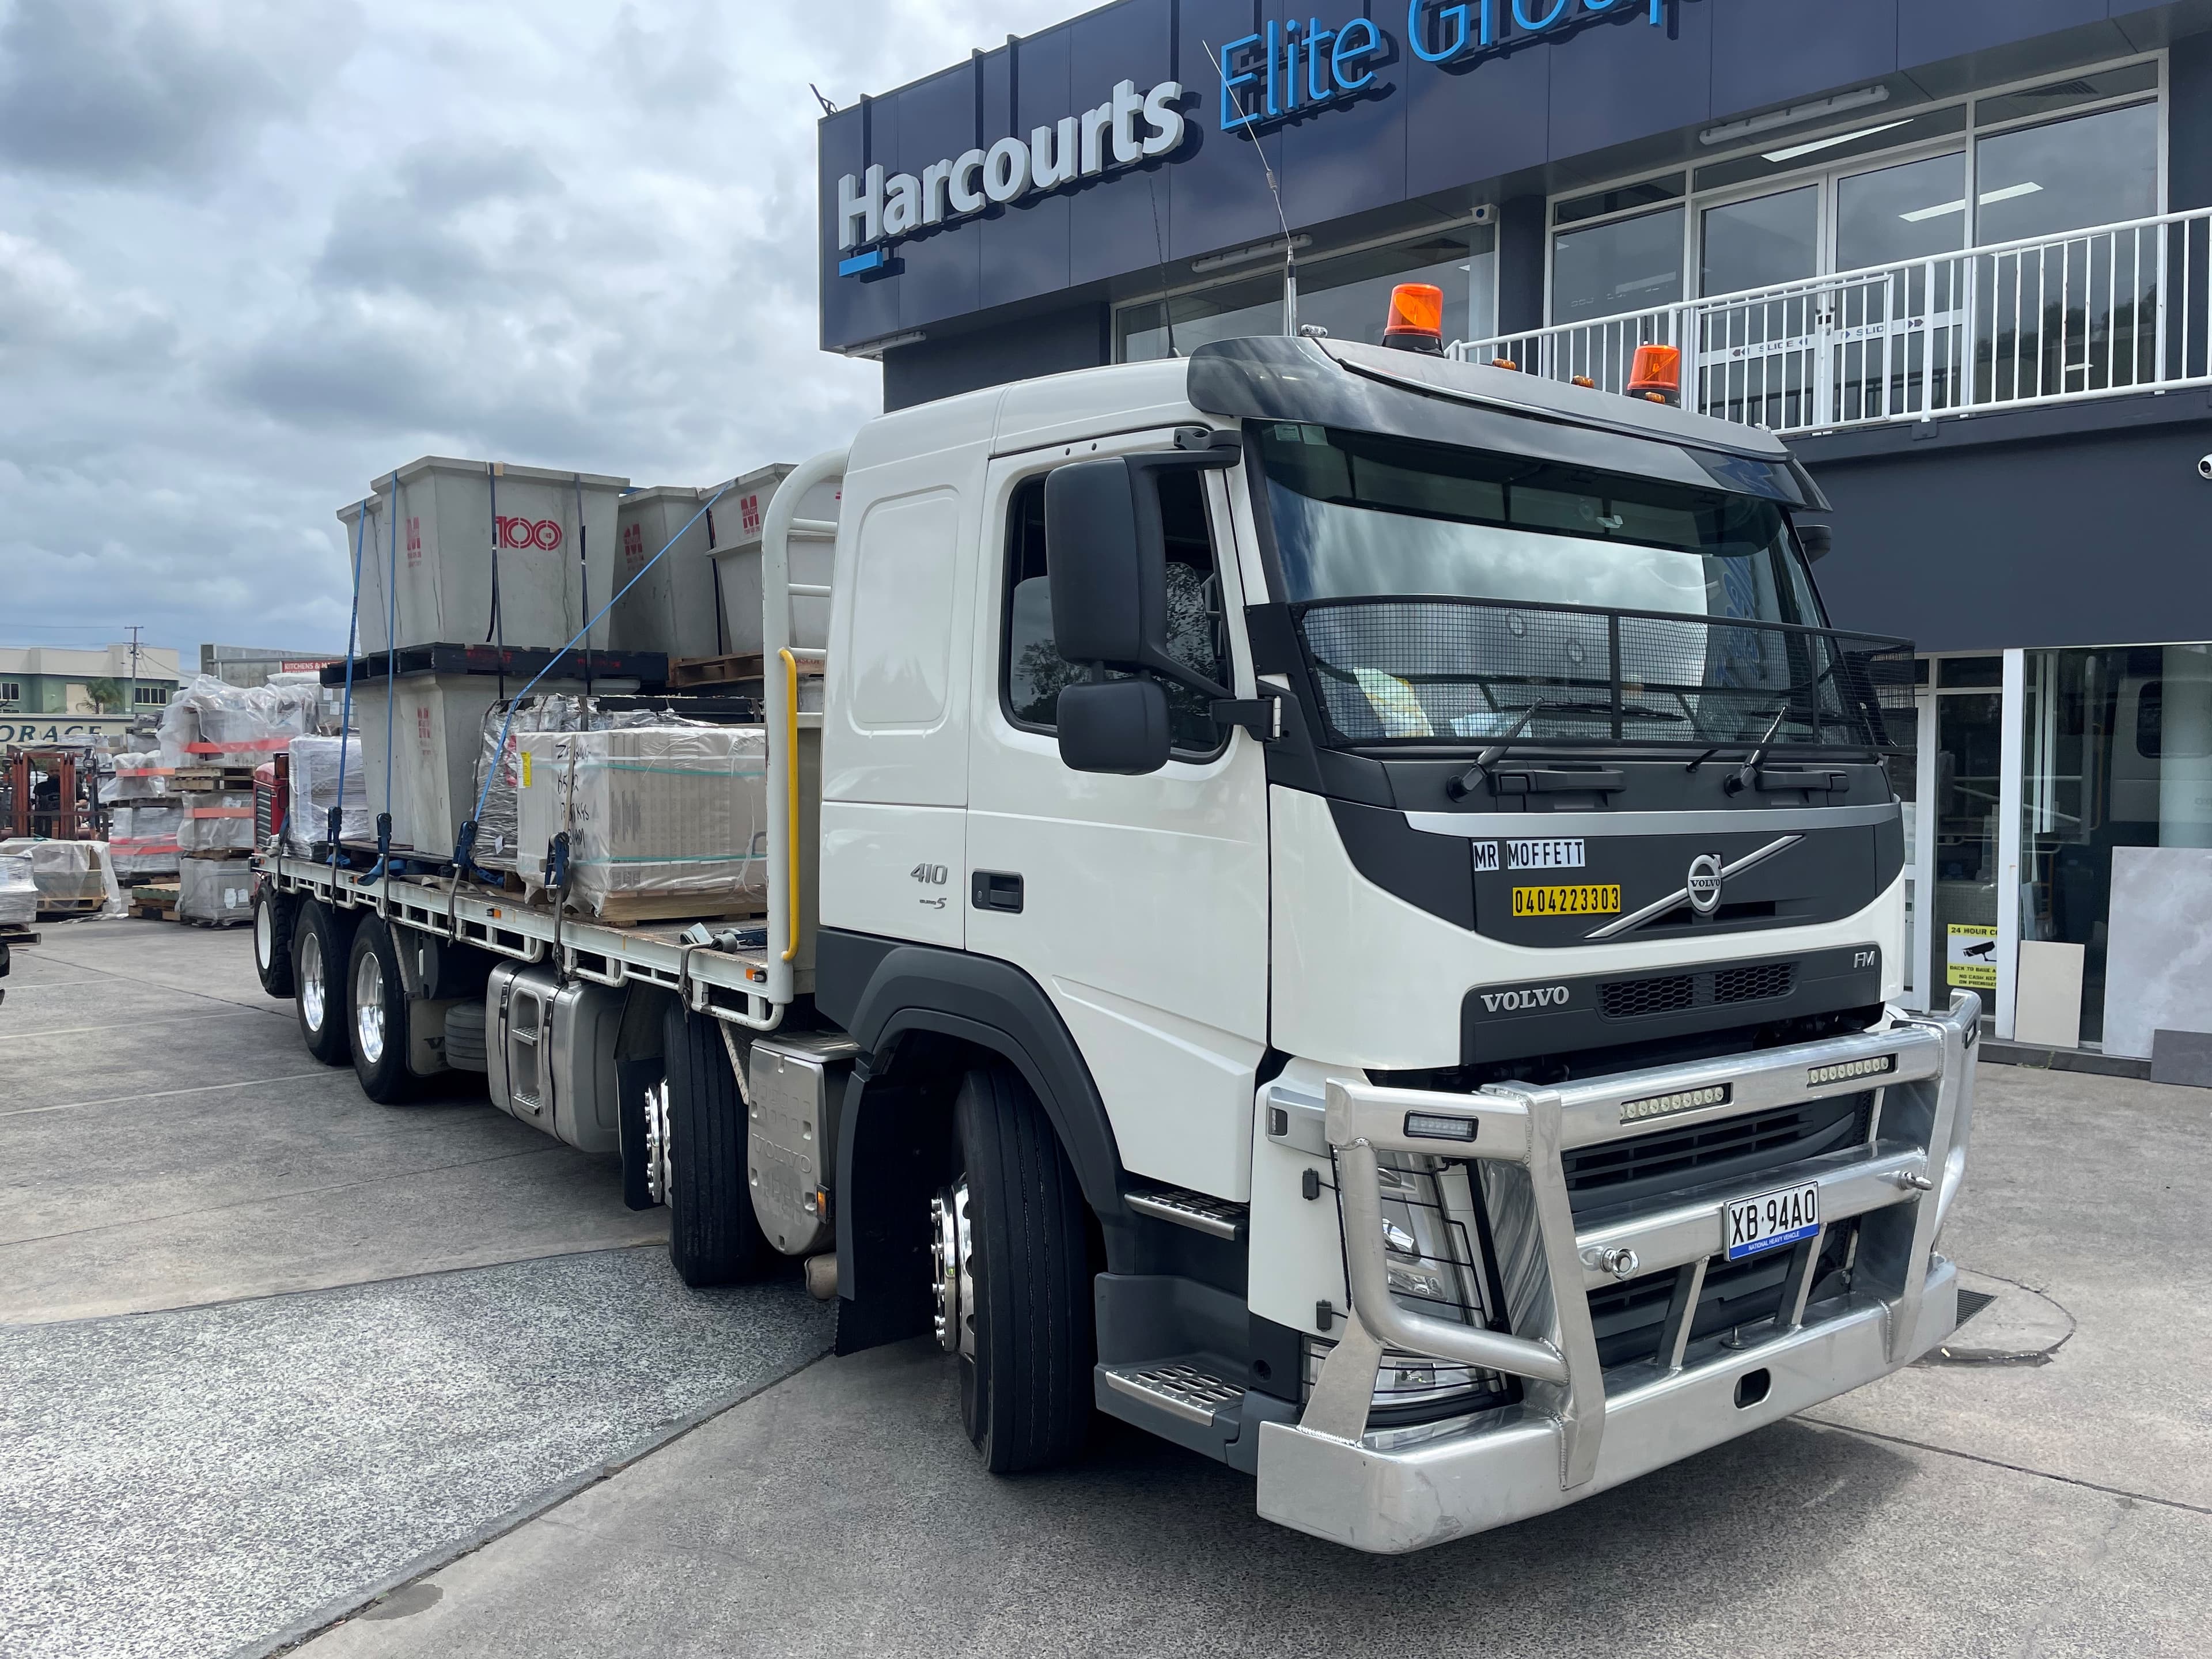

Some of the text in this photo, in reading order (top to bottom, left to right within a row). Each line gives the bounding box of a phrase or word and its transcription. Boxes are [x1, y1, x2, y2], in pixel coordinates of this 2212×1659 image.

[838, 79, 1184, 252] Harcourts
[1221, 17, 1381, 134] Elite
[495, 516, 562, 551] 100
[1474, 842, 1582, 869] MR MOFFETT
[910, 863, 948, 885] 410
[1690, 879, 1720, 887] VOLVO
[1515, 888, 1618, 914] 0404223303
[1854, 950, 1875, 968] FM
[1480, 986, 1570, 1013] VOLVO
[752, 1133, 812, 1173] VOLVO
[1748, 1231, 1800, 1251] NATIONAL HEAVY VEHICLE
